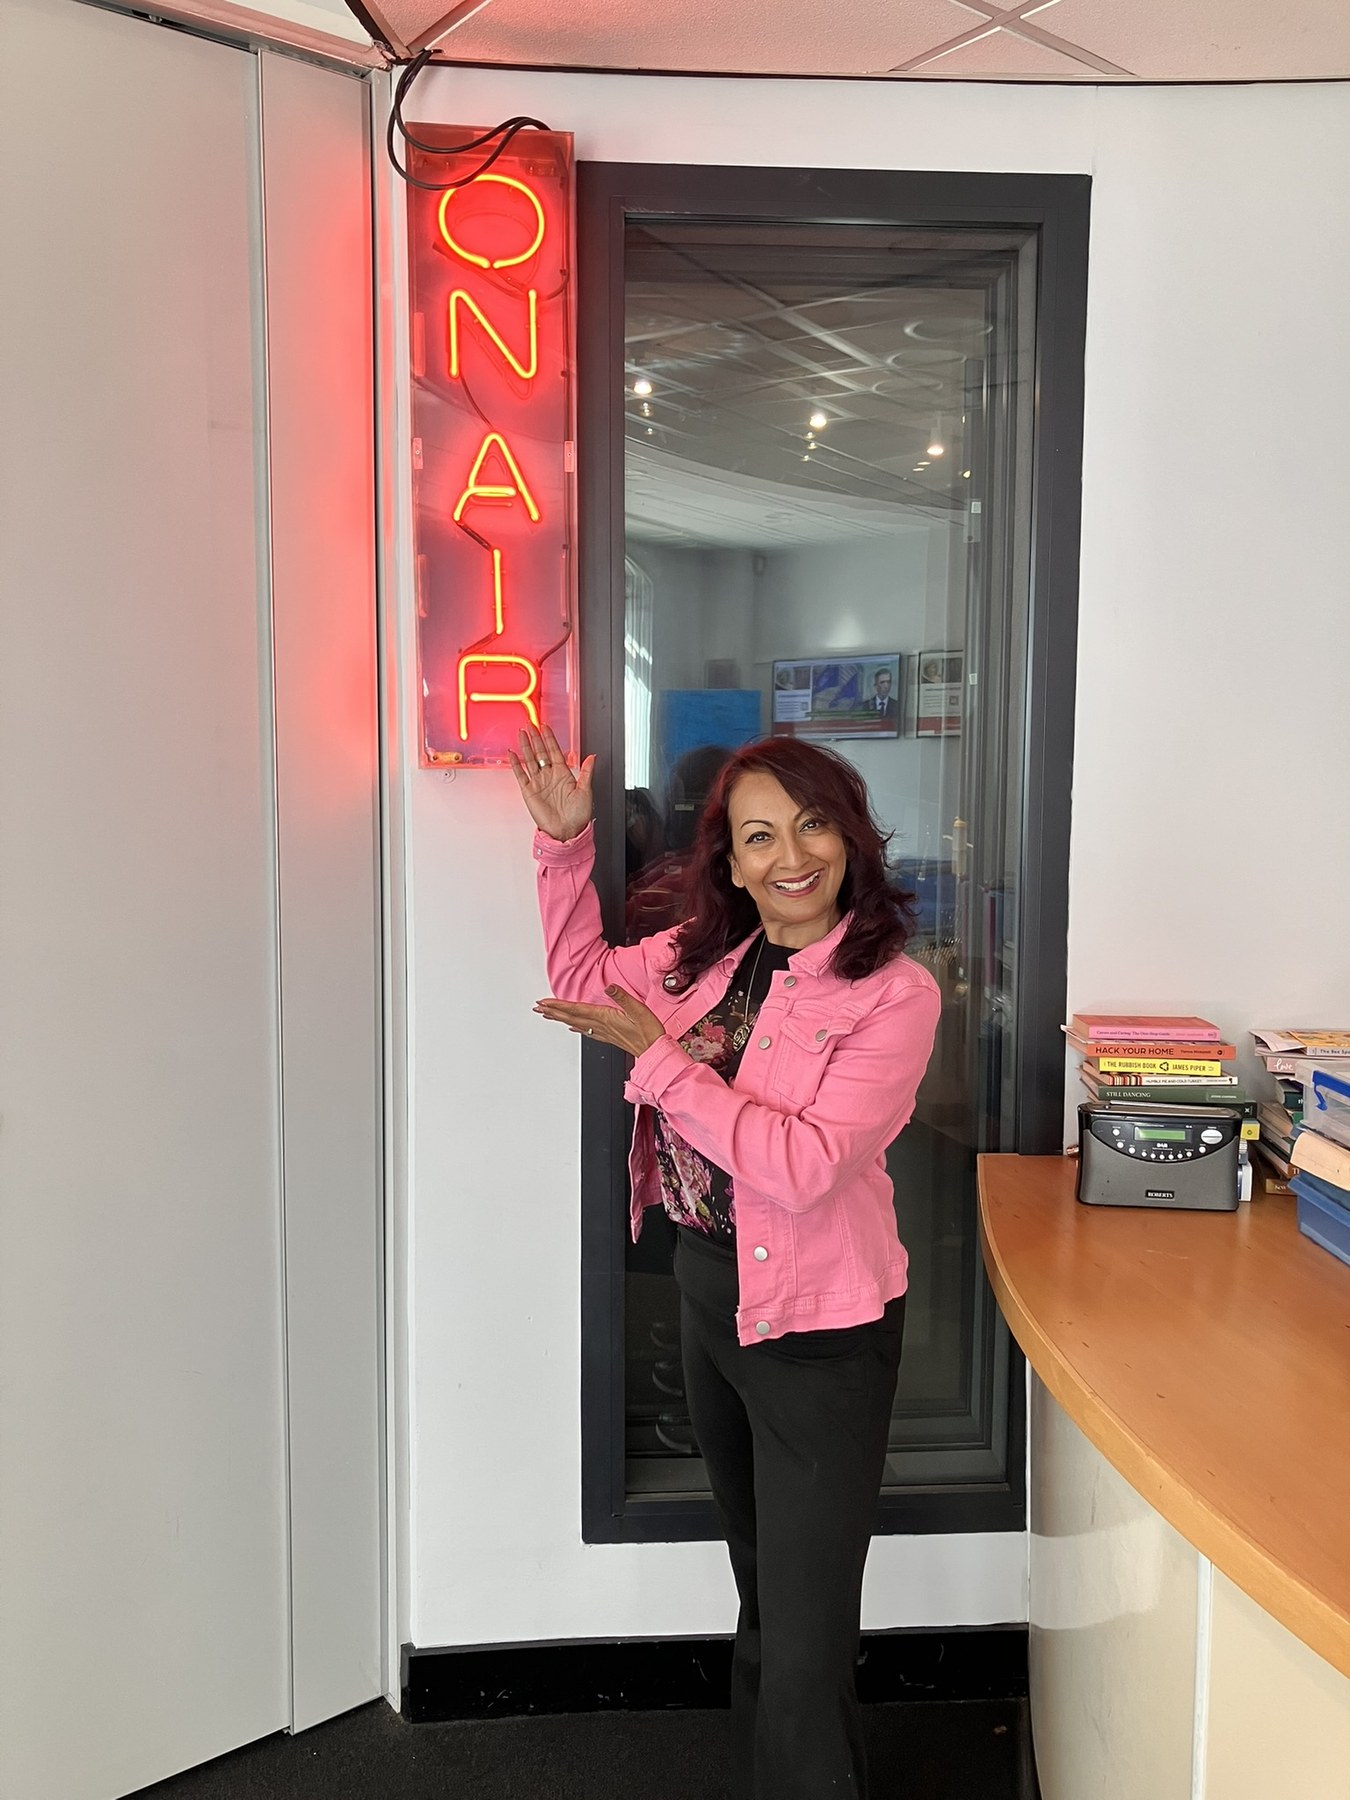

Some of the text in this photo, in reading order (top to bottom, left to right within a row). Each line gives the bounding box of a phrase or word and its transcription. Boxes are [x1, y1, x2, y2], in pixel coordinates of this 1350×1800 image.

[437, 173, 546, 741] ON AIR
[1122, 1047, 1147, 1055] YOUR
[1148, 1048, 1174, 1056] HOME
